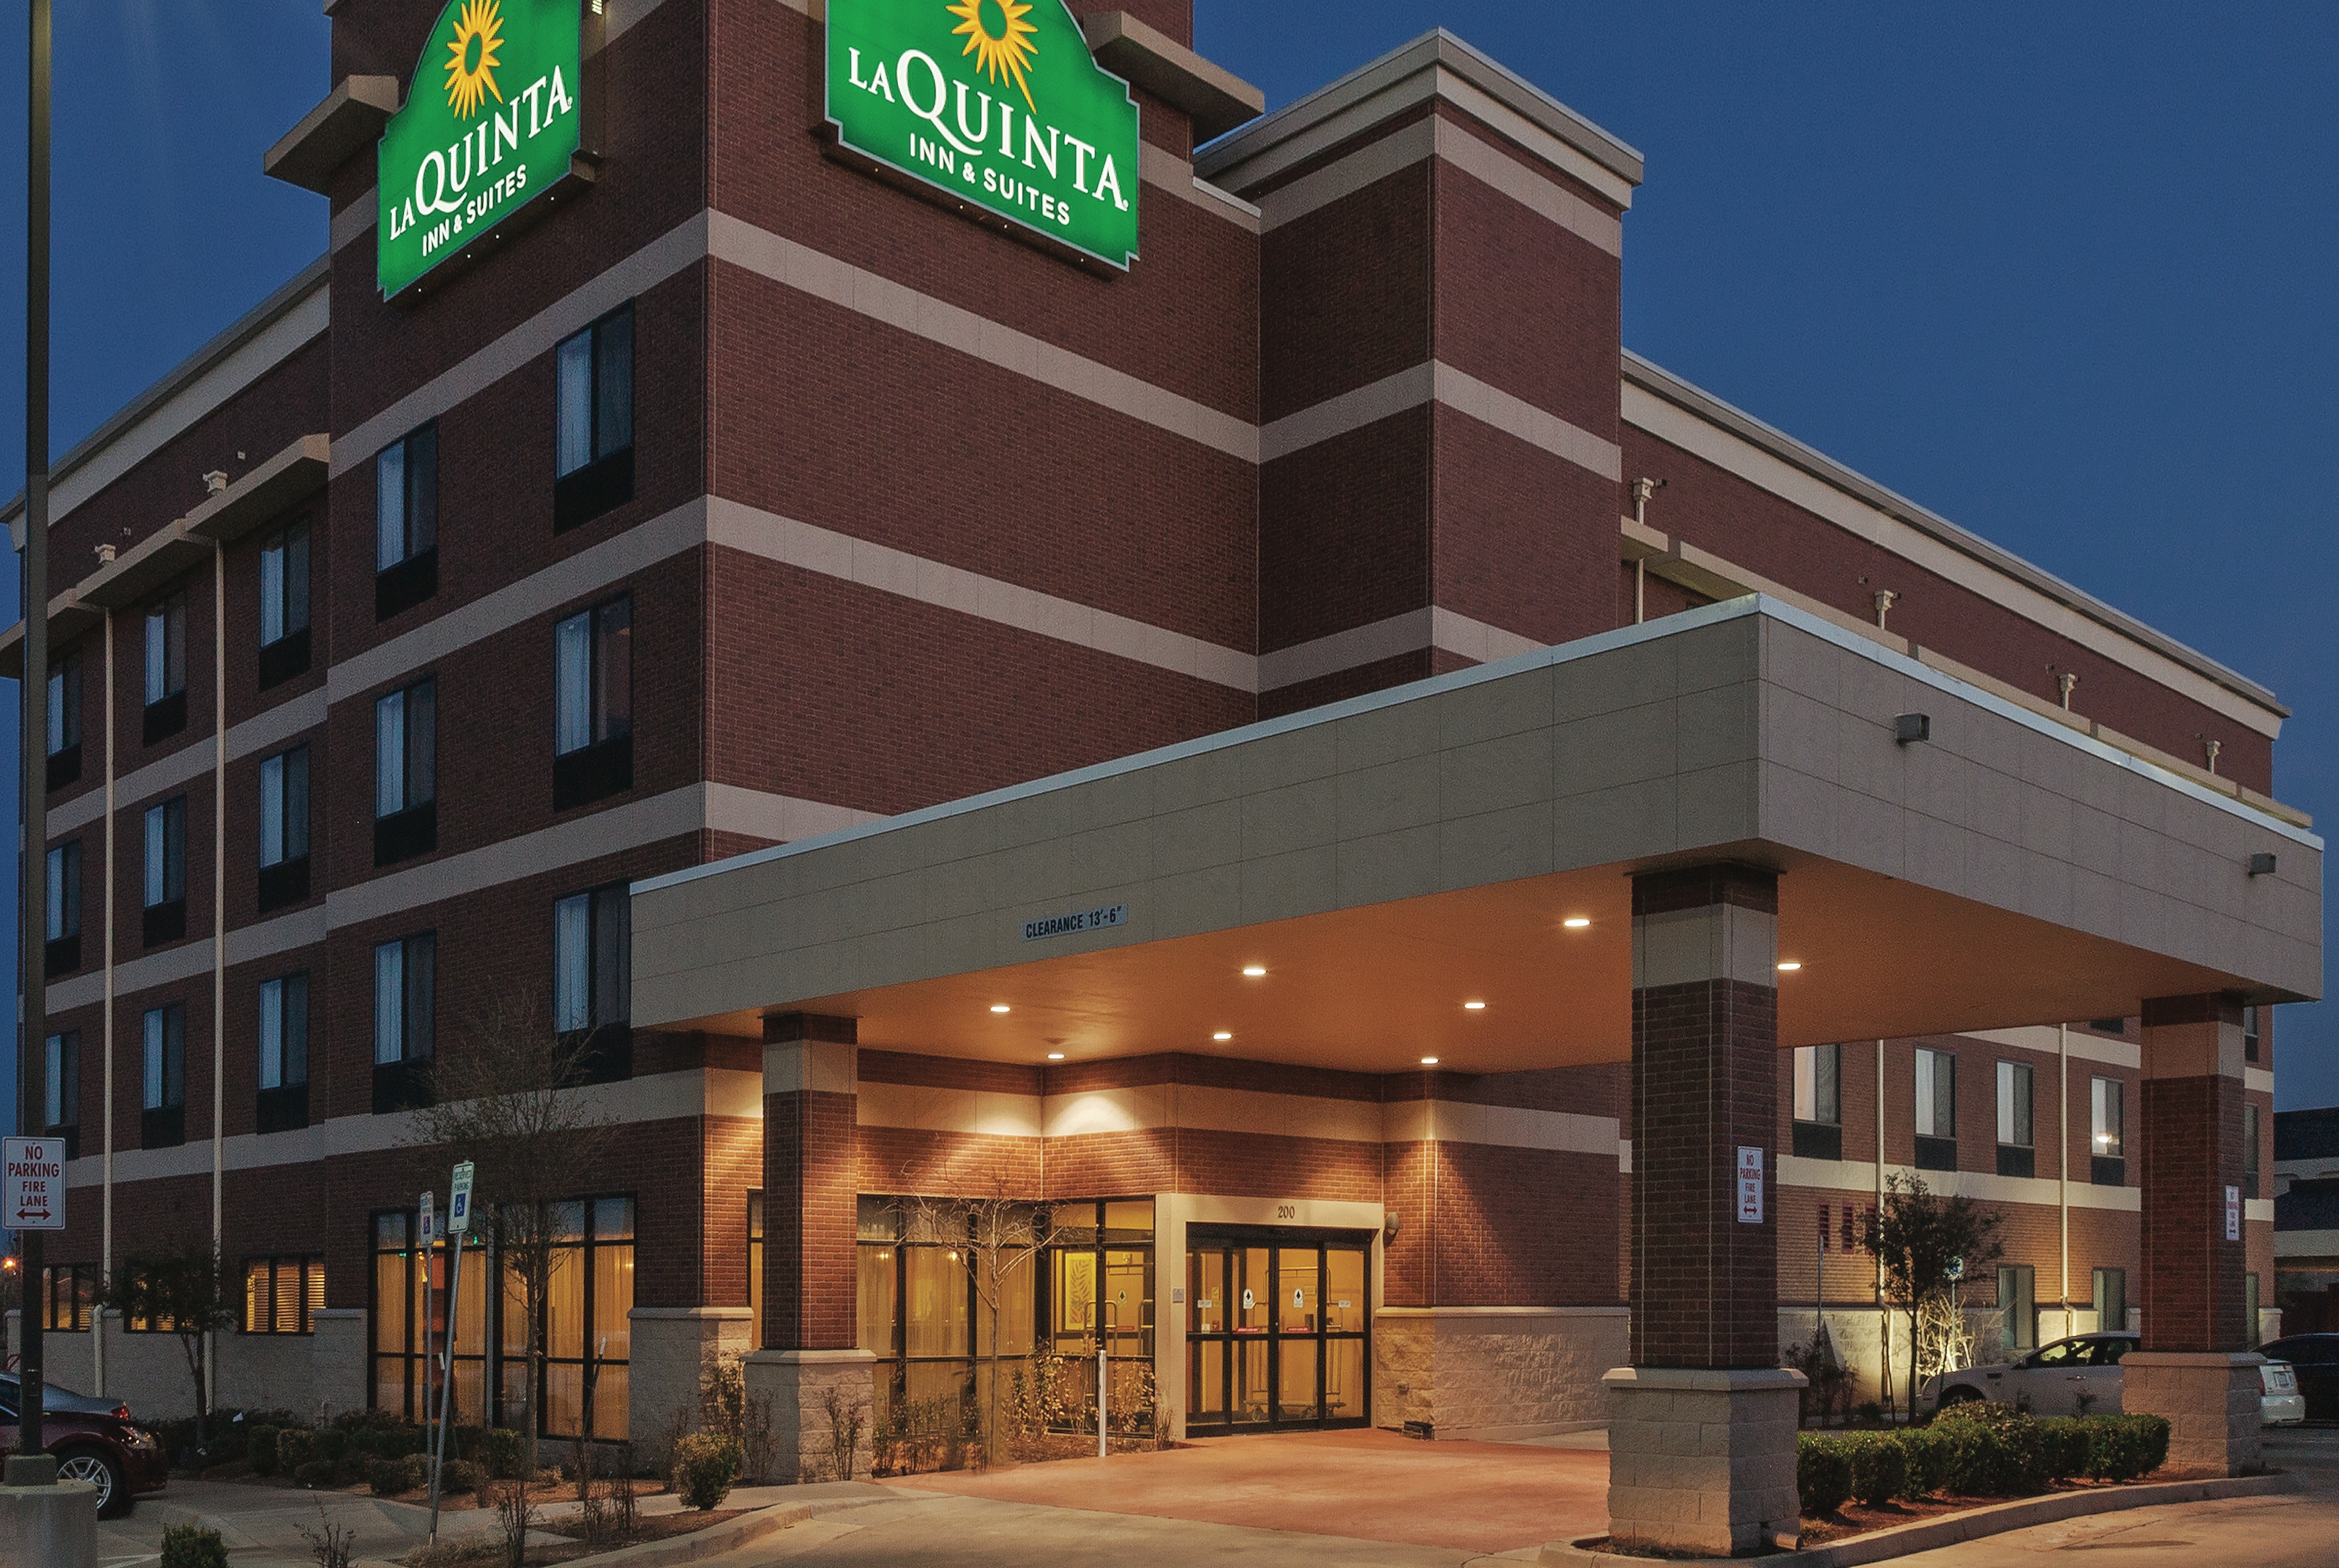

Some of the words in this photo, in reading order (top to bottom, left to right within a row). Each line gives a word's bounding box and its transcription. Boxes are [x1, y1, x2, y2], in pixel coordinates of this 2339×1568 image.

[849, 47, 895, 103] LA
[896, 49, 1129, 212] QUINTA
[389, 197, 416, 241] LA
[416, 65, 572, 213] QUINTA
[909, 133, 954, 175] INN
[962, 162, 975, 184] &
[983, 168, 1071, 226] SUITES
[422, 218, 450, 257] INN
[453, 215, 463, 234] &
[466, 164, 527, 224] SUITES
[1026, 914, 1084, 938] CLEARANCE
[25, 1145, 44, 1160] NO
[1746, 1154, 1754, 1166] NO
[8, 1162, 59, 1178] PARKING
[1739, 1167, 1761, 1180] PARKING
[22, 1181, 46, 1192] FIRE
[20, 1195, 48, 1207] LANE
[1277, 1205, 1295, 1218] 200
